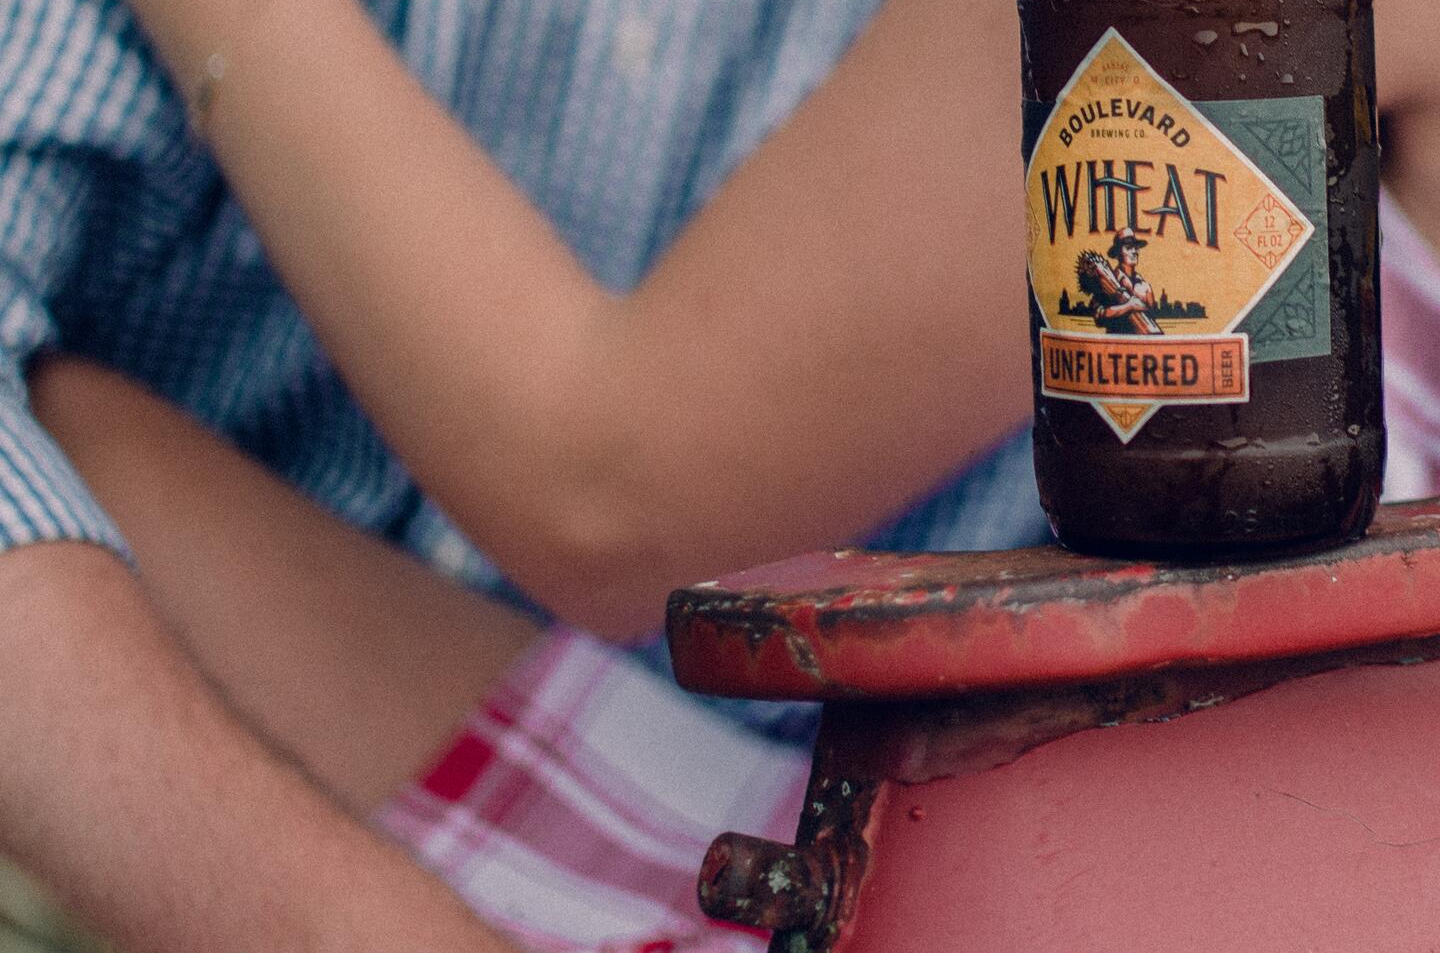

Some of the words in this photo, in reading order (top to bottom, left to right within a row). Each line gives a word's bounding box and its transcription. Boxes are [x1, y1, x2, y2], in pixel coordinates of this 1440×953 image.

[1058, 98, 1190, 148] BOULEVARD
[1090, 129, 1130, 139] BREWING
[1040, 159, 1227, 252] WHEAT
[1264, 216, 1275, 229] 12
[1257, 235, 1268, 248] FL
[1271, 234, 1282, 247] OZ
[1049, 346, 1199, 387] UNFILTERED
[1221, 349, 1233, 387] BEER
